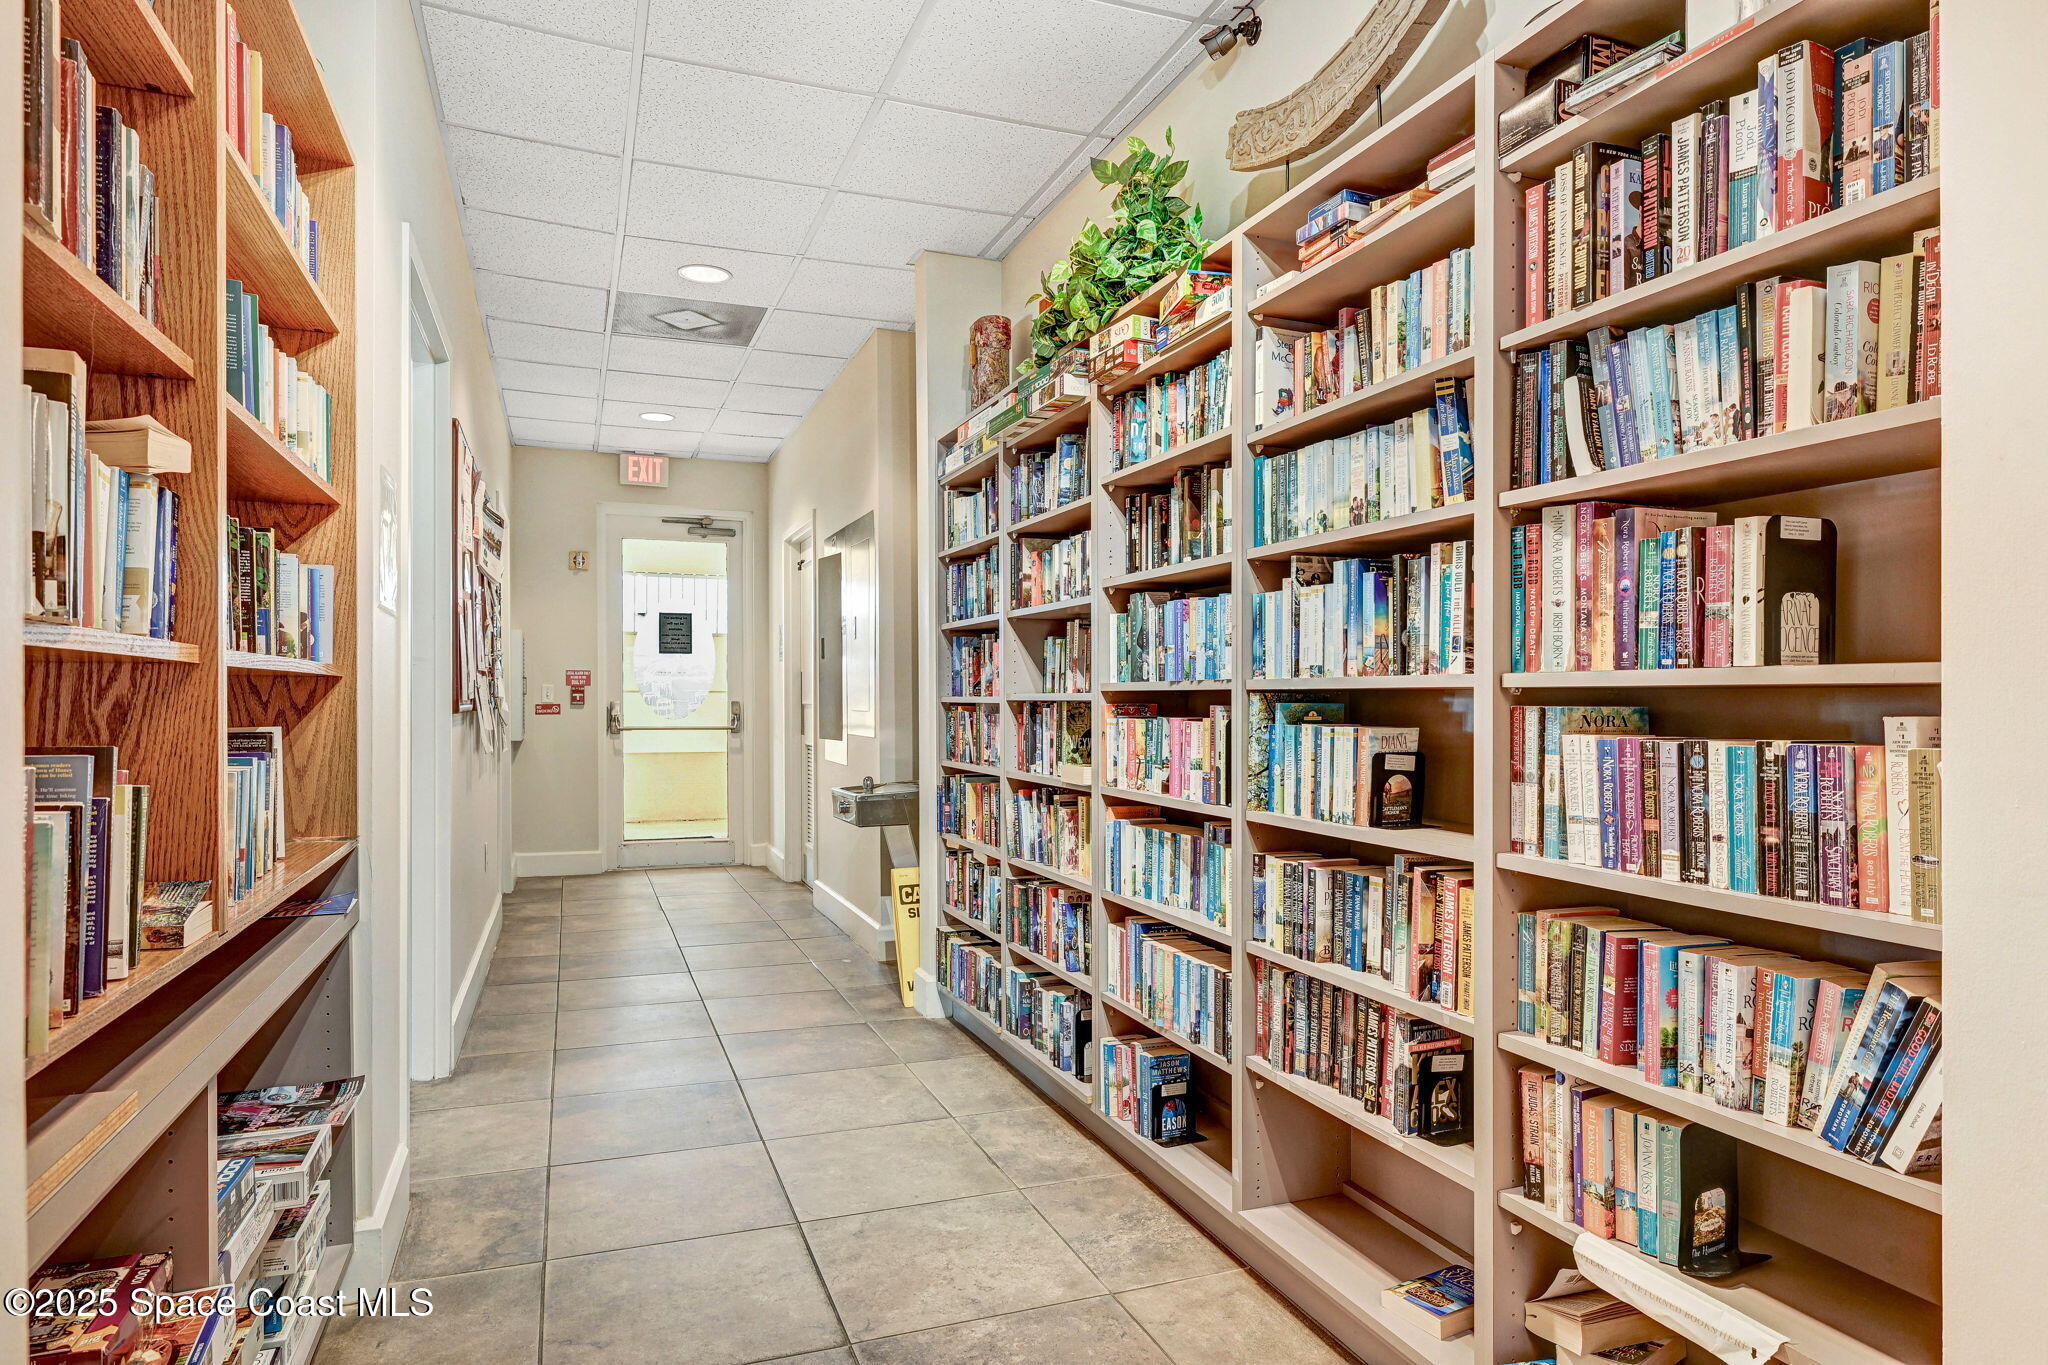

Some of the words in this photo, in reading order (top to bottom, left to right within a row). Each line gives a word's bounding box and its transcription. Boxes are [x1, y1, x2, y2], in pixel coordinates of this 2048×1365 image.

[1785, 68, 1796, 93] JODI
[79, 79, 88, 158] NICHOLAS
[1765, 111, 1773, 130] Jodi
[1785, 95, 1796, 143] PICOULT
[1848, 93, 1856, 133] PICOULT
[1858, 97, 1867, 120] JODI
[1736, 119, 1746, 162] Picoult
[1747, 124, 1757, 150] Jodi
[1677, 137, 1690, 175] JAMES
[1575, 154, 1584, 189] CRICHTON
[79, 163, 87, 215] SPARKS
[1574, 192, 1584, 230] PATTERSON
[1678, 178, 1690, 243] PATTERSON
[1574, 244, 1587, 289] ERUPTION
[1846, 290, 1854, 313] SARA
[1833, 303, 1842, 336] Colorado
[1720, 338, 1729, 373] RAMSAY
[1830, 337, 1841, 367] Cowboy
[1845, 316, 1854, 374] RICHARDSON
[628, 455, 663, 483] EXIT
[1444, 460, 1454, 486] Monroe
[1451, 453, 1460, 469] Mary
[1453, 471, 1461, 491] Alice
[1552, 523, 1564, 554] NORA
[1622, 517, 1632, 539] Nora
[1455, 546, 1464, 569] CHRIS
[1579, 538, 1587, 581] ROBERTS
[1622, 541, 1630, 571] Roberts
[1454, 572, 1463, 593] OULD
[1552, 556, 1564, 596] ROBERTS
[1644, 568, 1653, 609] ROBERTS
[1708, 558, 1717, 601] ROBERTS
[1717, 564, 1725, 593] NORA
[1453, 597, 1462, 612] THE
[1579, 587, 1587, 630] MONTANA
[1453, 614, 1462, 635] KILLI
[1552, 612, 1563, 633] IRISH
[1622, 600, 1630, 643] Inheritance
[1552, 635, 1563, 660] BORN
[1527, 711, 1535, 733] NORA
[1579, 711, 1629, 729] NORA
[1381, 735, 1408, 750] DIANA
[1604, 758, 1614, 780] NORA
[1625, 773, 1634, 790] NORA
[1644, 769, 1656, 787] NORA
[1604, 782, 1613, 812] ROBERTS
[1667, 777, 1676, 803] NORA
[1692, 783, 1705, 804] NORA
[1734, 774, 1744, 800] NORA
[1821, 776, 1834, 820] ROBERTS
[1626, 791, 1634, 818] ROBERTS
[1644, 791, 1655, 818] ROBERTS
[1832, 791, 1844, 821] NORA
[1919, 791, 1932, 816] NORA
[1667, 806, 1676, 842] ROBERTS
[1691, 805, 1705, 838] ROBERTS
[1734, 802, 1744, 837] ROBERTS
[1920, 818, 1932, 851] ROBERTS
[1827, 846, 1841, 892] SANCTUARY
[1444, 890, 1454, 920] JAMES
[1435, 903, 1443, 939] PATTERSON
[1462, 920, 1471, 942] JAMES
[1443, 922, 1455, 974] PATTERSON
[1462, 943, 1471, 978] PATTERSON
[1587, 968, 1595, 985] NORA
[1296, 1000, 1305, 1019] JAMES
[1322, 995, 1330, 1016] JAMES
[1586, 987, 1595, 1013] ROBERTS
[1688, 979, 1696, 1012] SHEILA
[1726, 987, 1735, 1022] SHEILA
[1821, 988, 1835, 1019] SHEILA
[1368, 1009, 1378, 1037] JAMES
[1601, 1001, 1609, 1027] NORA
[1606, 996, 1614, 1036] ROBERTS
[1755, 1012, 1763, 1045] Christmas
[1296, 1020, 1305, 1050] PATTERSON
[1321, 1018, 1330, 1054] PATTERSON
[1688, 1013, 1696, 1055] ROBERTS
[1725, 1024, 1734, 1065] ROBERTS
[1816, 1021, 1830, 1063] ROBERTS
[1152, 1066, 1188, 1076] MATTHEWS
[1159, 1060, 1180, 1068] JASON
[1366, 1038, 1378, 1083] PATTERSON
[1386, 1041, 1394, 1081] PATTERSON
[1754, 1046, 1762, 1069] Wishes
[1770, 1078, 1779, 1116] ROBERTS
[1779, 1083, 1787, 1115] SHEILA
[1161, 1116, 1187, 1130] EASON
[1580, 1254, 1609, 1273] PLEASE
[1630, 1281, 1682, 1314] RETURNED
[1684, 1310, 1717, 1333] BOOKS
[1718, 1329, 1750, 1350] HERE
